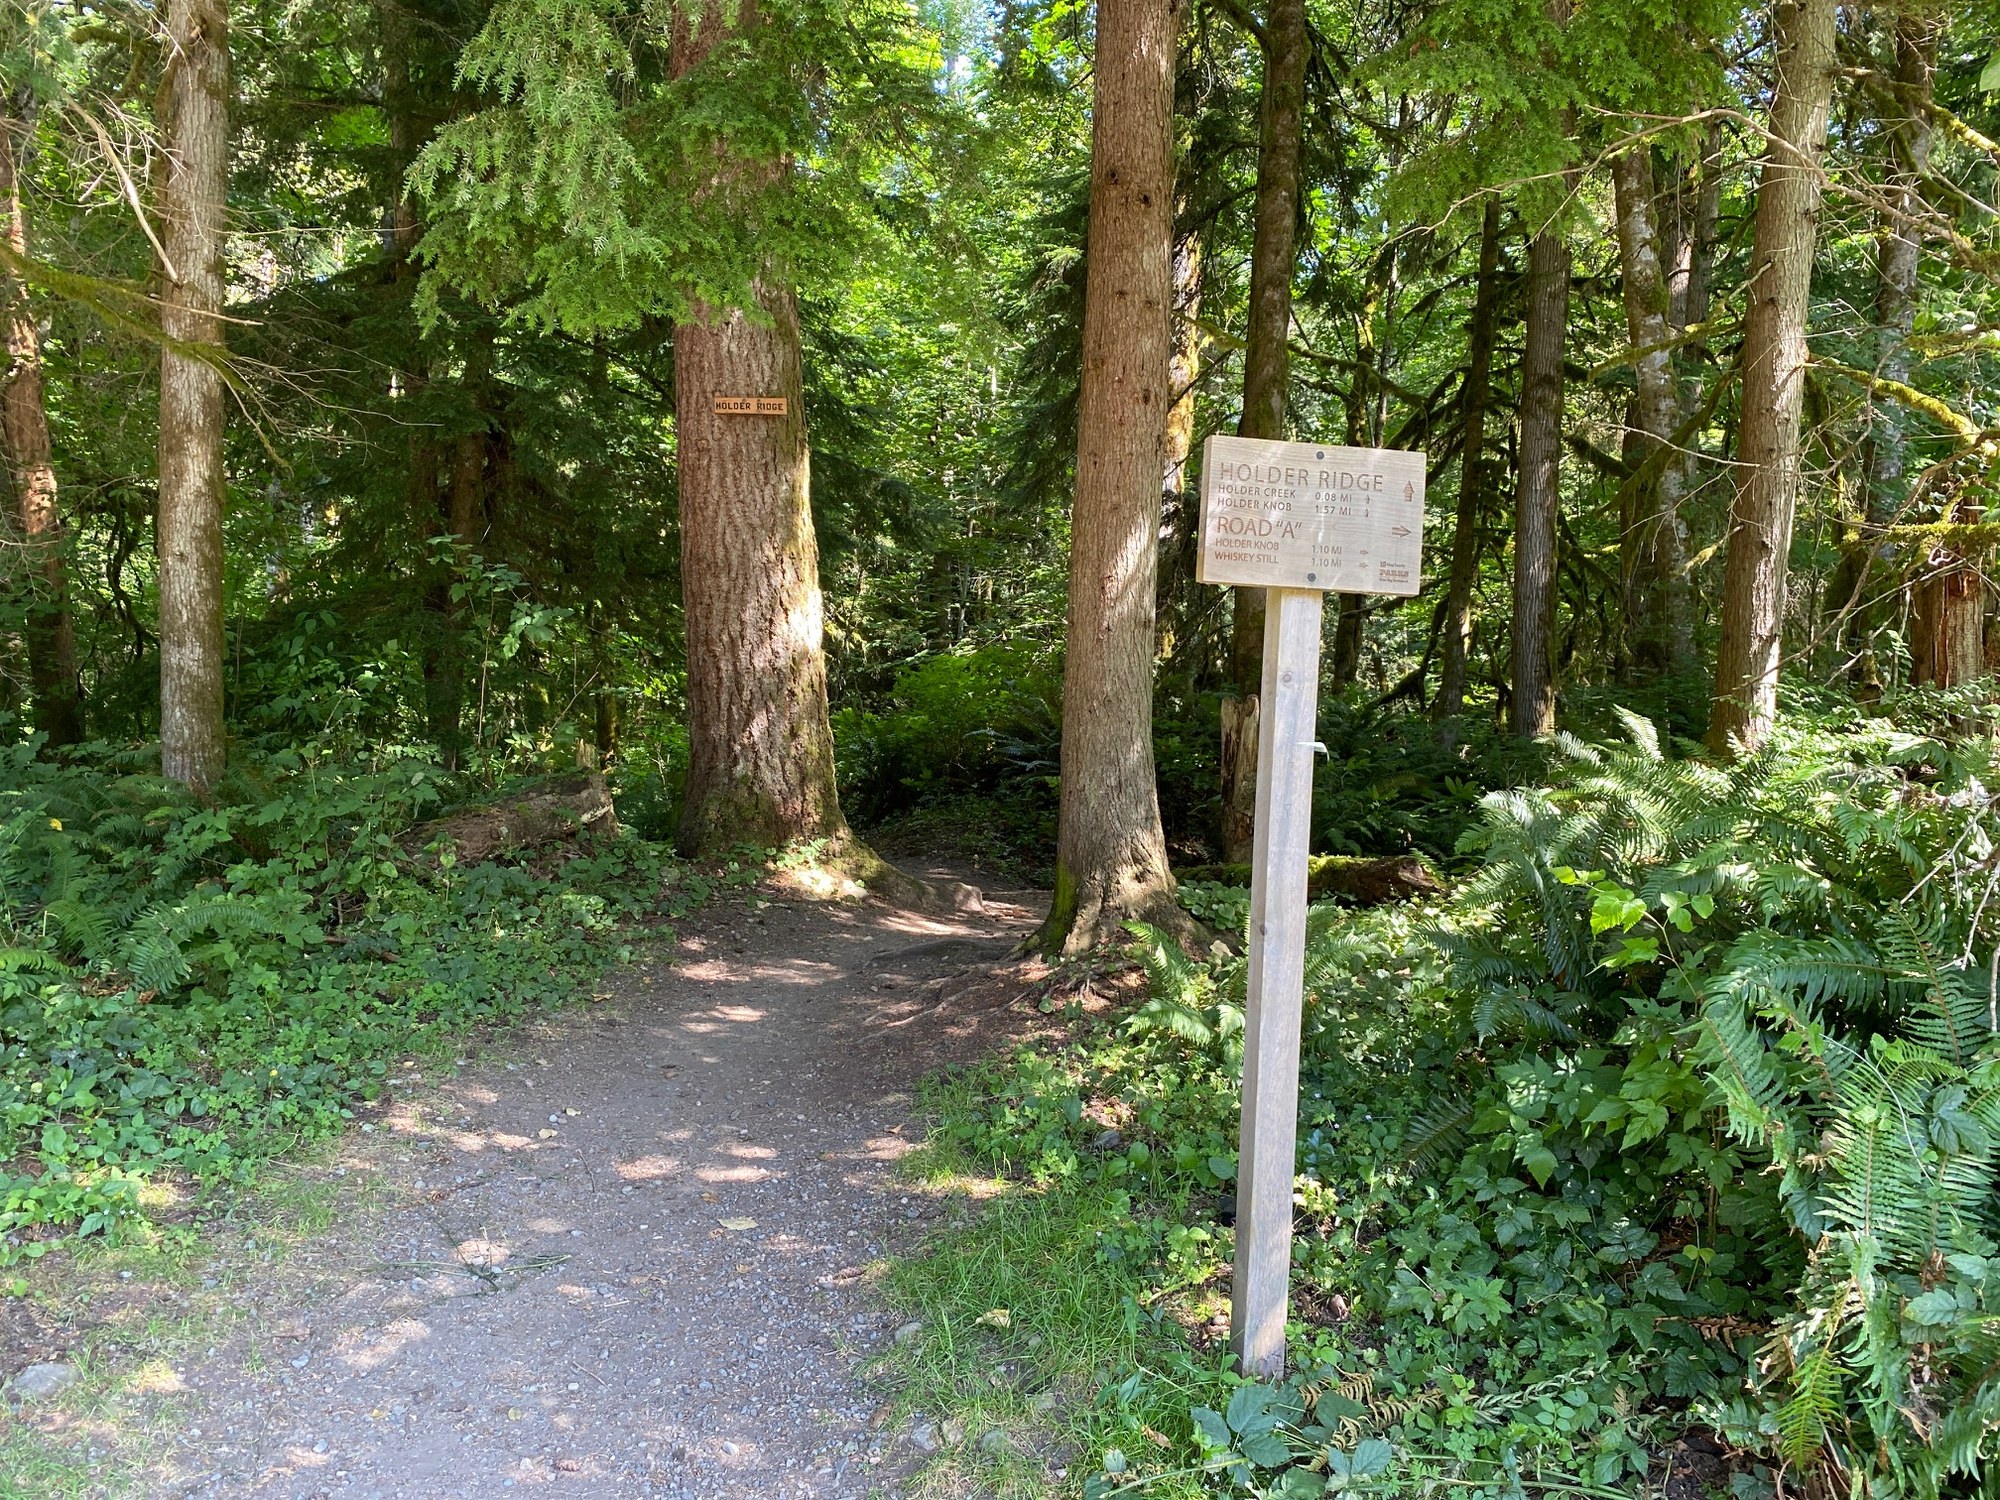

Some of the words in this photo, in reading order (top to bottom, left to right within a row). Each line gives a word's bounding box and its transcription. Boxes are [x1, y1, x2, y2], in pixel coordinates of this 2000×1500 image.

[715, 401, 751, 410] HOLDER
[756, 402, 784, 411] RIDGE
[1220, 462, 1309, 487] HOLDER
[1318, 470, 1384, 493] RIDGE
[1218, 484, 1260, 496] HOLDER
[1264, 488, 1296, 499] CREEK
[1315, 492, 1337, 502] 0.08
[1340, 494, 1352, 503] MI
[1217, 497, 1259, 509] HOLDER
[1263, 501, 1292, 512] KNOB
[1315, 505, 1335, 515] 1.57
[1339, 506, 1351, 516] MI
[1215, 538, 1252, 549] HOLDER
[1254, 540, 1280, 551] KNOB
[1311, 544, 1329, 554] 1.10
[1331, 546, 1342, 555] MI
[1214, 551, 1254, 563] WHISKEY
[1256, 554, 1279, 564] STILL
[1311, 557, 1329, 567] 1.10
[1330, 557, 1342, 568] MI
